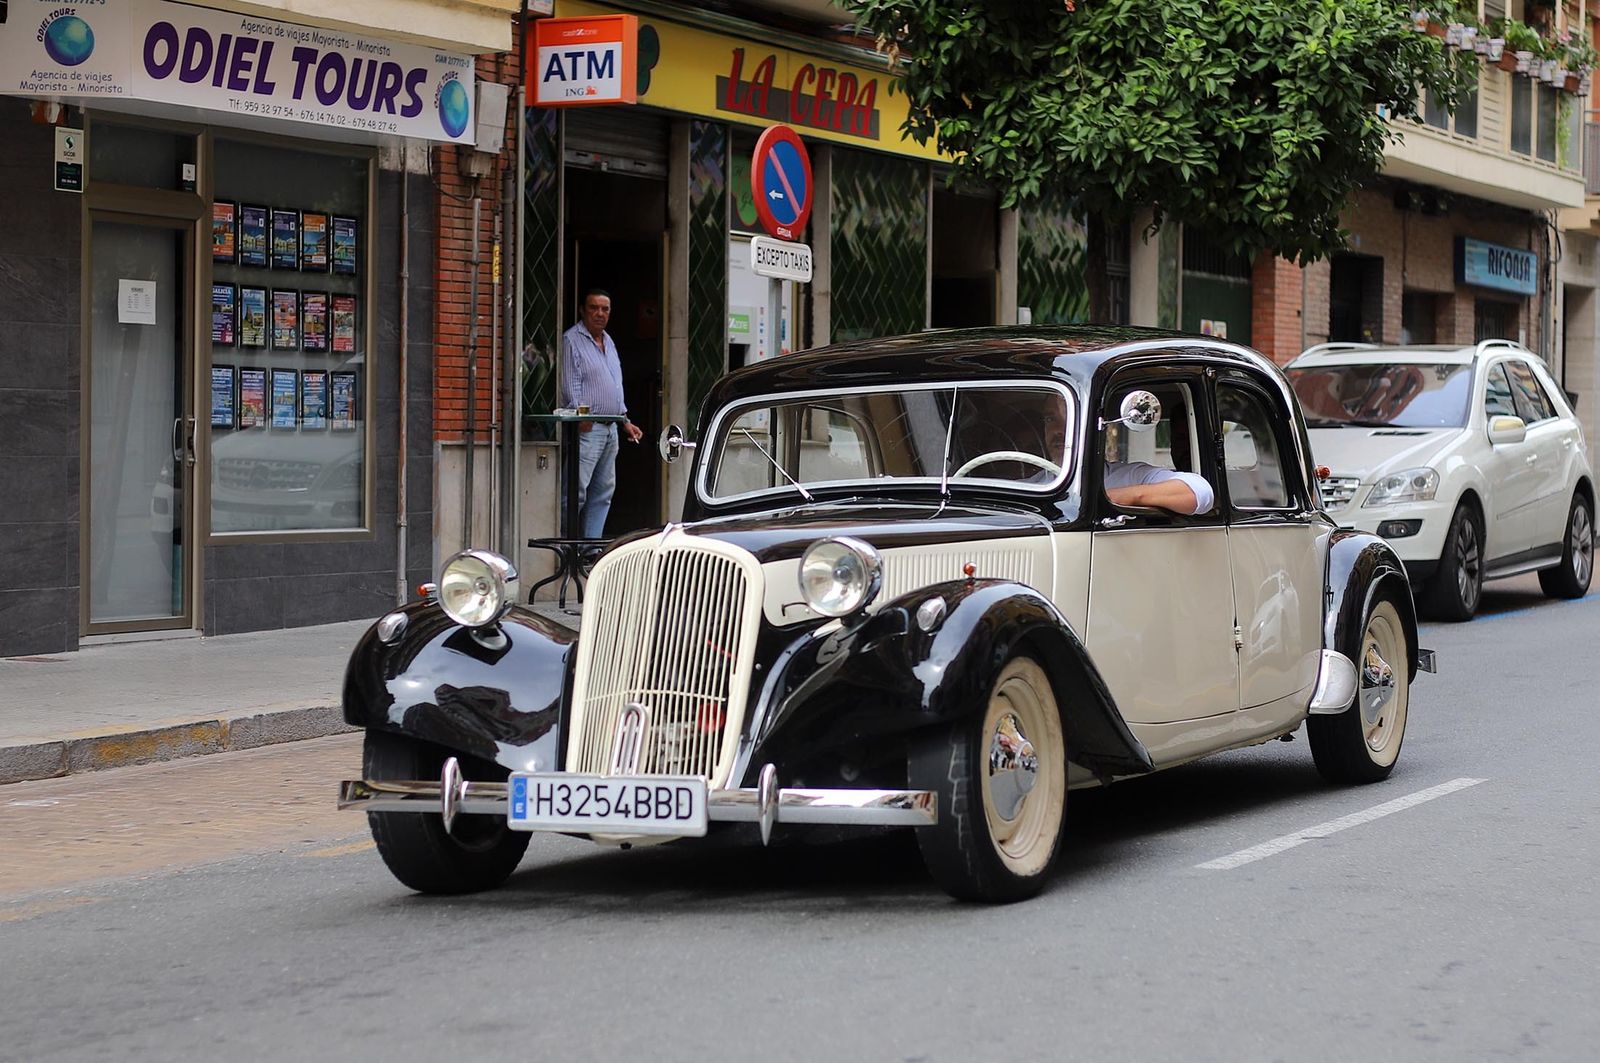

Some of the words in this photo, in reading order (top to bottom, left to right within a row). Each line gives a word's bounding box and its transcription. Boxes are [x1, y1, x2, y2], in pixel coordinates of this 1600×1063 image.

[37, 18, 50, 42] ODIEL
[49, 8, 76, 20] TOURS
[241, 19, 272, 36] Agencia
[274, 26, 284, 38] de
[286, 27, 310, 44] viajes
[311, 31, 349, 49] Mayorista
[356, 40, 391, 57] Minorista
[31, 70, 67, 82] Agencia
[70, 71, 82, 80] de
[85, 72, 113, 83] viajes
[143, 21, 276, 96] ODIEL
[292, 46, 428, 118] TOURS
[543, 49, 614, 83] ATM
[20, 81, 67, 93] Mayorista
[77, 83, 123, 93] Minorista
[565, 87, 585, 97] ING
[726, 47, 777, 115] LA
[789, 62, 878, 136] CEPA
[245, 101, 259, 113] 959
[261, 103, 271, 114] 32
[272, 105, 283, 116] 97
[284, 107, 294, 117] 54
[301, 110, 315, 121] 676
[317, 112, 325, 122] 14
[326, 114, 336, 124] 76
[337, 115, 347, 126] 02
[353, 118, 367, 129] 679
[368, 120, 377, 130] 48
[379, 121, 388, 132] 27
[388, 123, 398, 133] 42
[776, 227, 793, 238] GRUA
[757, 246, 789, 269] EXCEPTO
[790, 252, 810, 272] TAXIS
[1487, 246, 1531, 283] RIFONSA
[514, 802, 524, 814] E
[535, 782, 694, 821] H3254BBD
